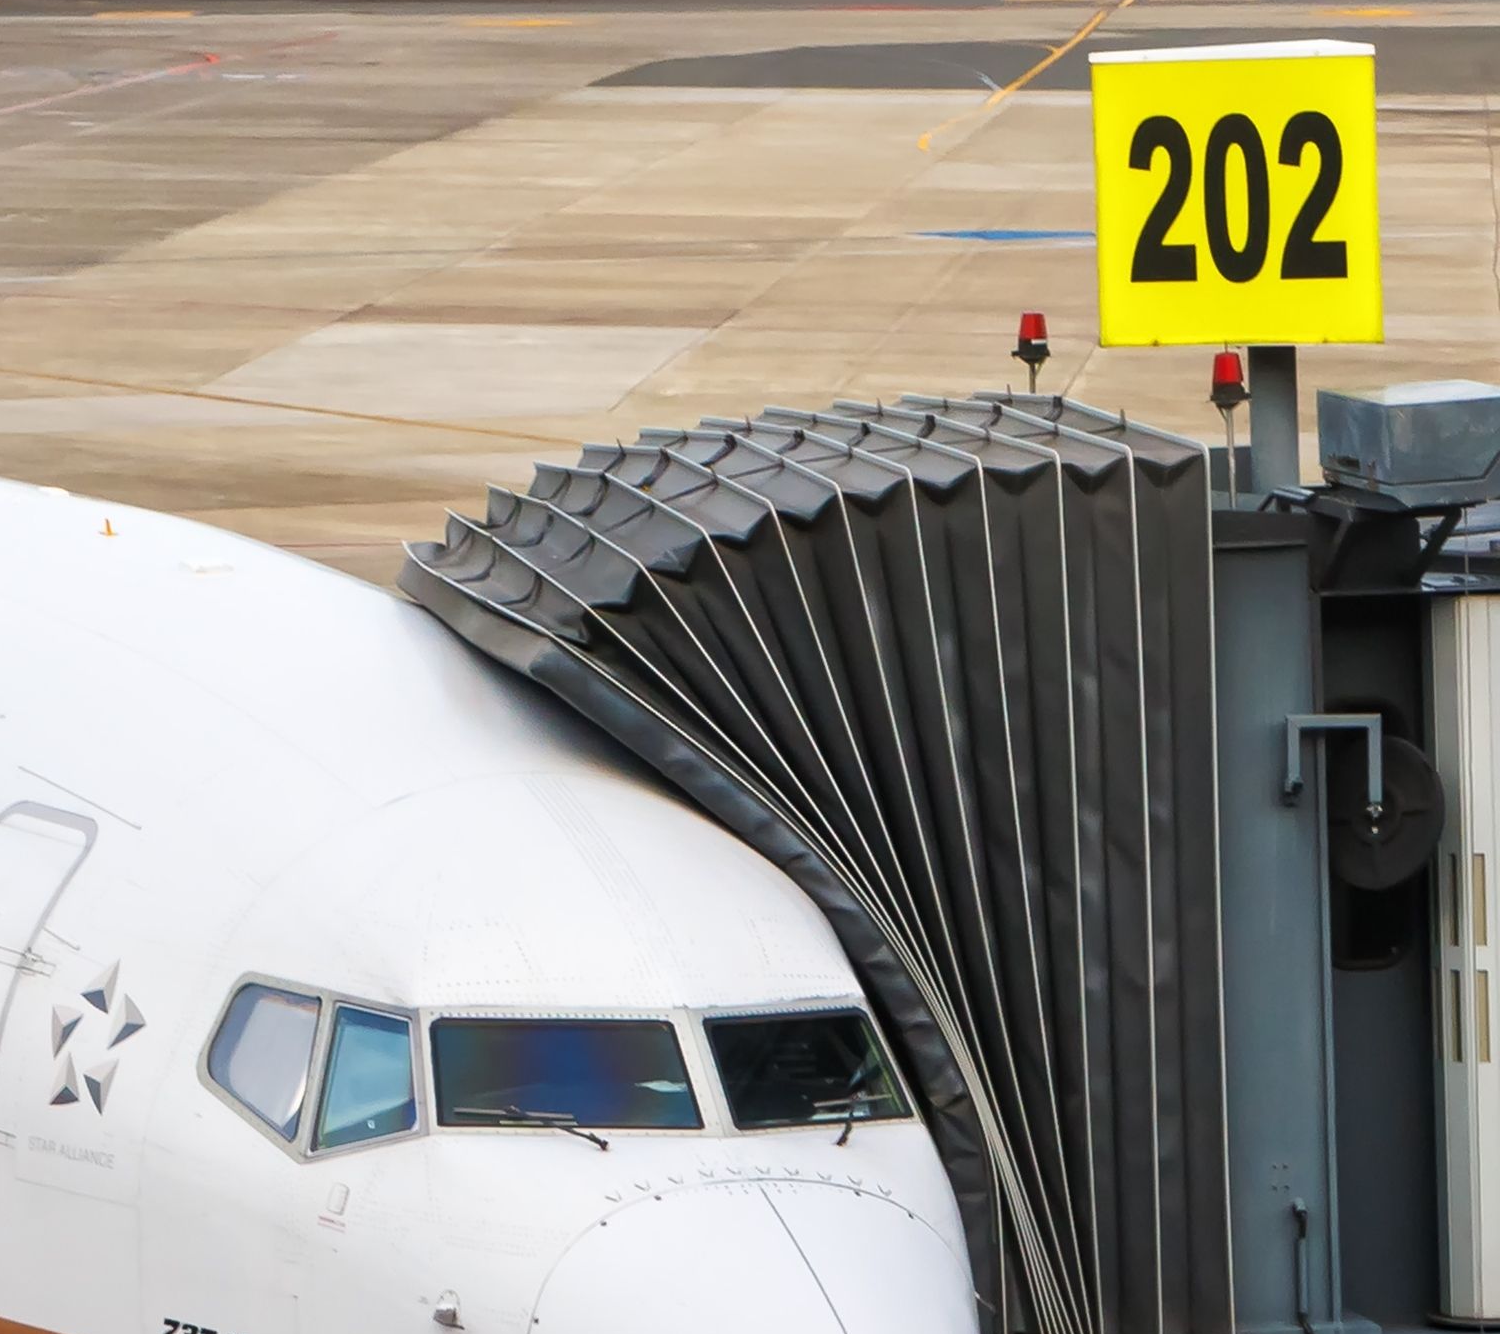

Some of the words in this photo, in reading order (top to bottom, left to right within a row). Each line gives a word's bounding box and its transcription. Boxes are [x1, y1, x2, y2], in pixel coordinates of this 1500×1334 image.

[1128, 110, 1349, 285] 202
[27, 1135, 57, 1155] STAR
[60, 1143, 116, 1170] ALLIANCE
